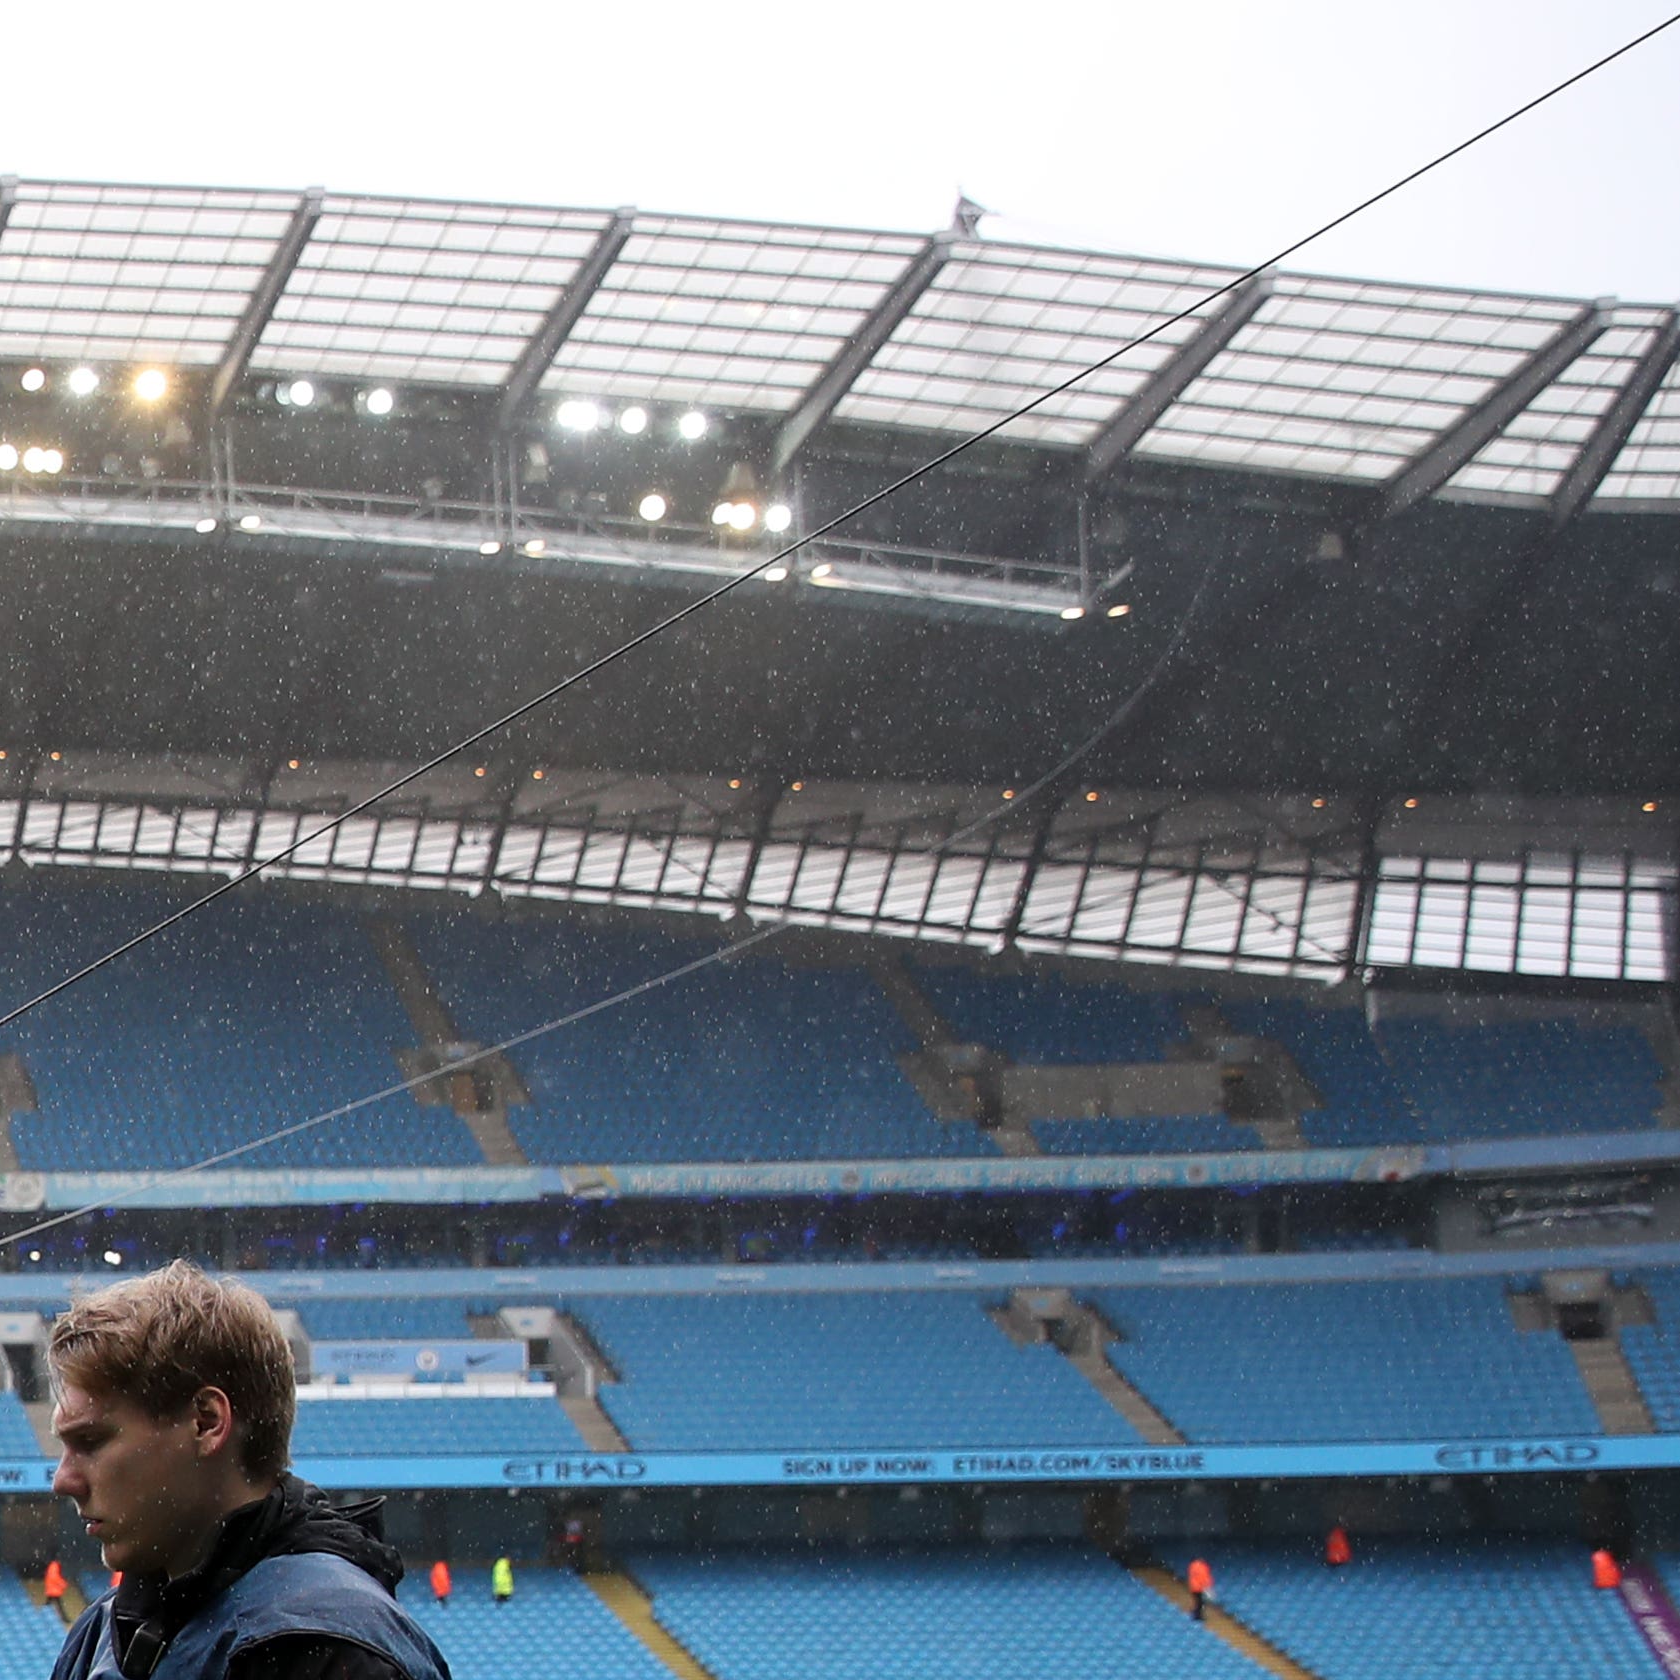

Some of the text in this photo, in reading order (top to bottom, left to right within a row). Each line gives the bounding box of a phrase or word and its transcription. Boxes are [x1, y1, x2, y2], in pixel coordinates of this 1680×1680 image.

[1433, 1442, 1600, 1467] ETIHAD
[502, 1459, 647, 1482] ETIHAD
[783, 1459, 832, 1477] SIGN
[839, 1458, 868, 1475] UP
